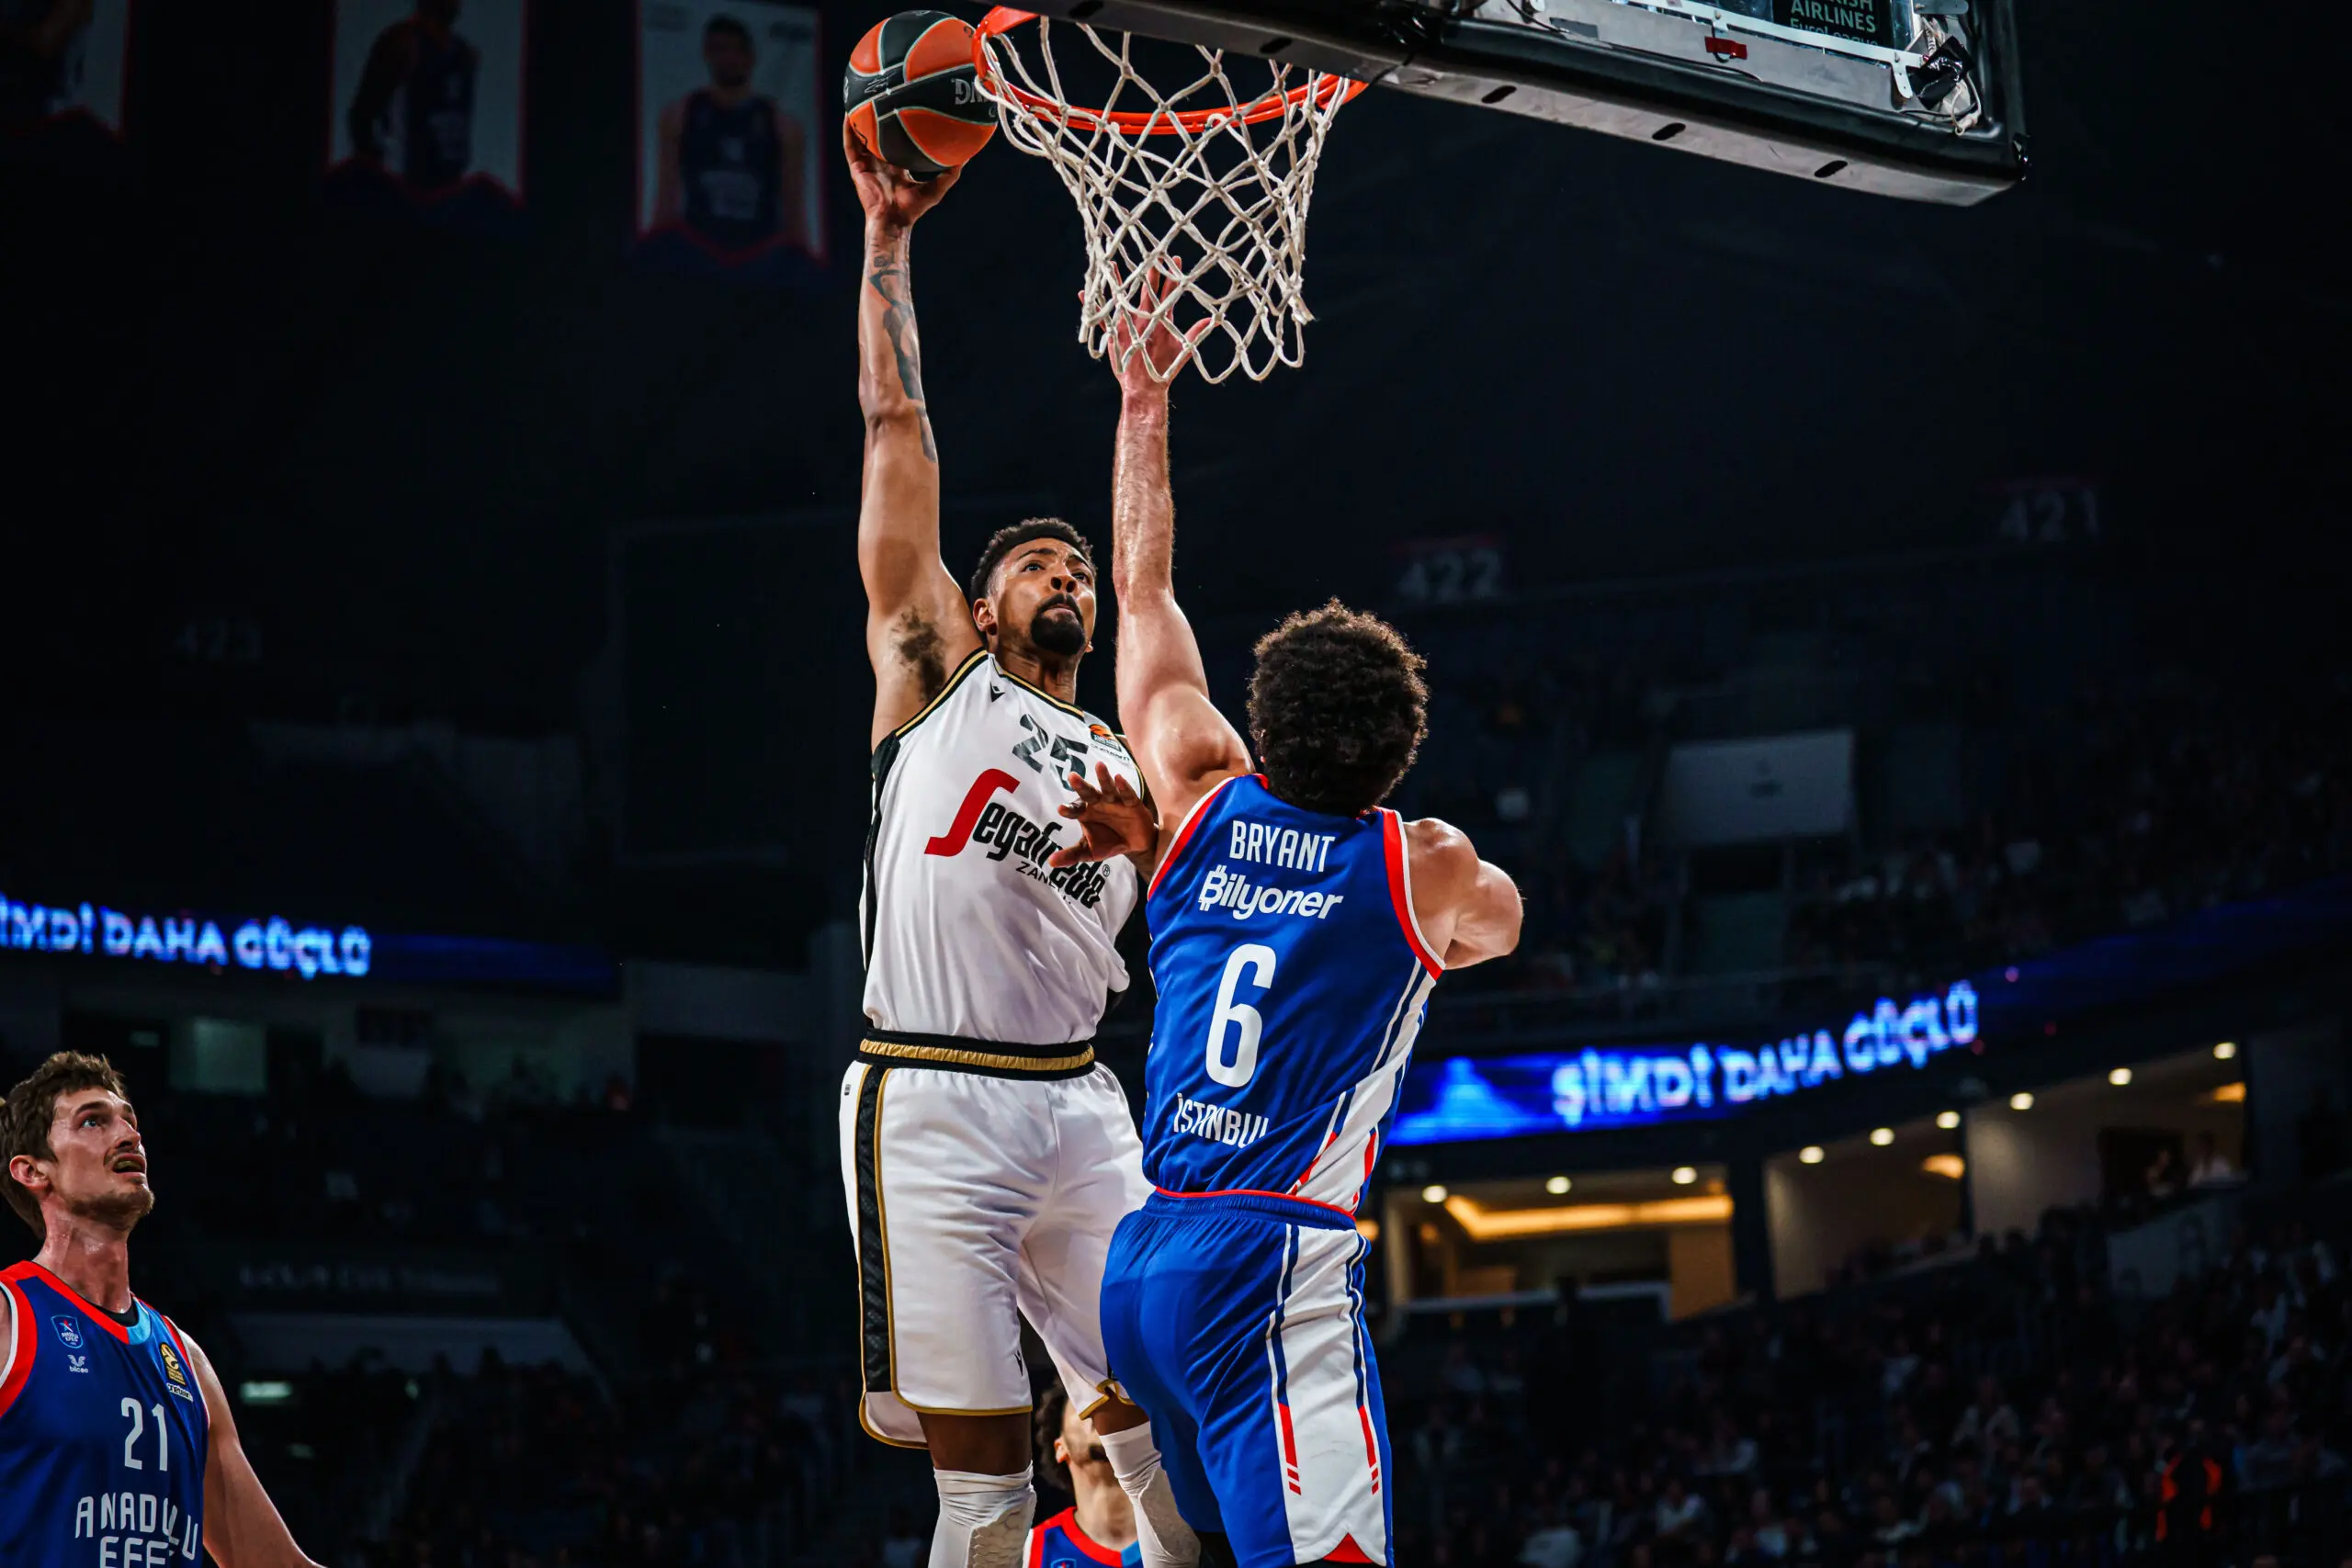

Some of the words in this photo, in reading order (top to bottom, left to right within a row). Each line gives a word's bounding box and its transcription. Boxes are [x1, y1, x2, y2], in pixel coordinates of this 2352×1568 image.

[1791, 0, 1876, 33] AIRLINES
[1396, 549, 1501, 603] 422
[1012, 713, 1090, 792] 25
[1228, 819, 1335, 873] BRYANT
[1198, 864, 1344, 919] Bilyoner
[102, 908, 228, 965] DAHA
[1205, 943, 1276, 1088] 6
[1552, 1044, 1713, 1128] ŞİMDİ
[1719, 1030, 1841, 1103] DAHA
[120, 1397, 168, 1472] 21
[99, 1536, 175, 1568] EFE
